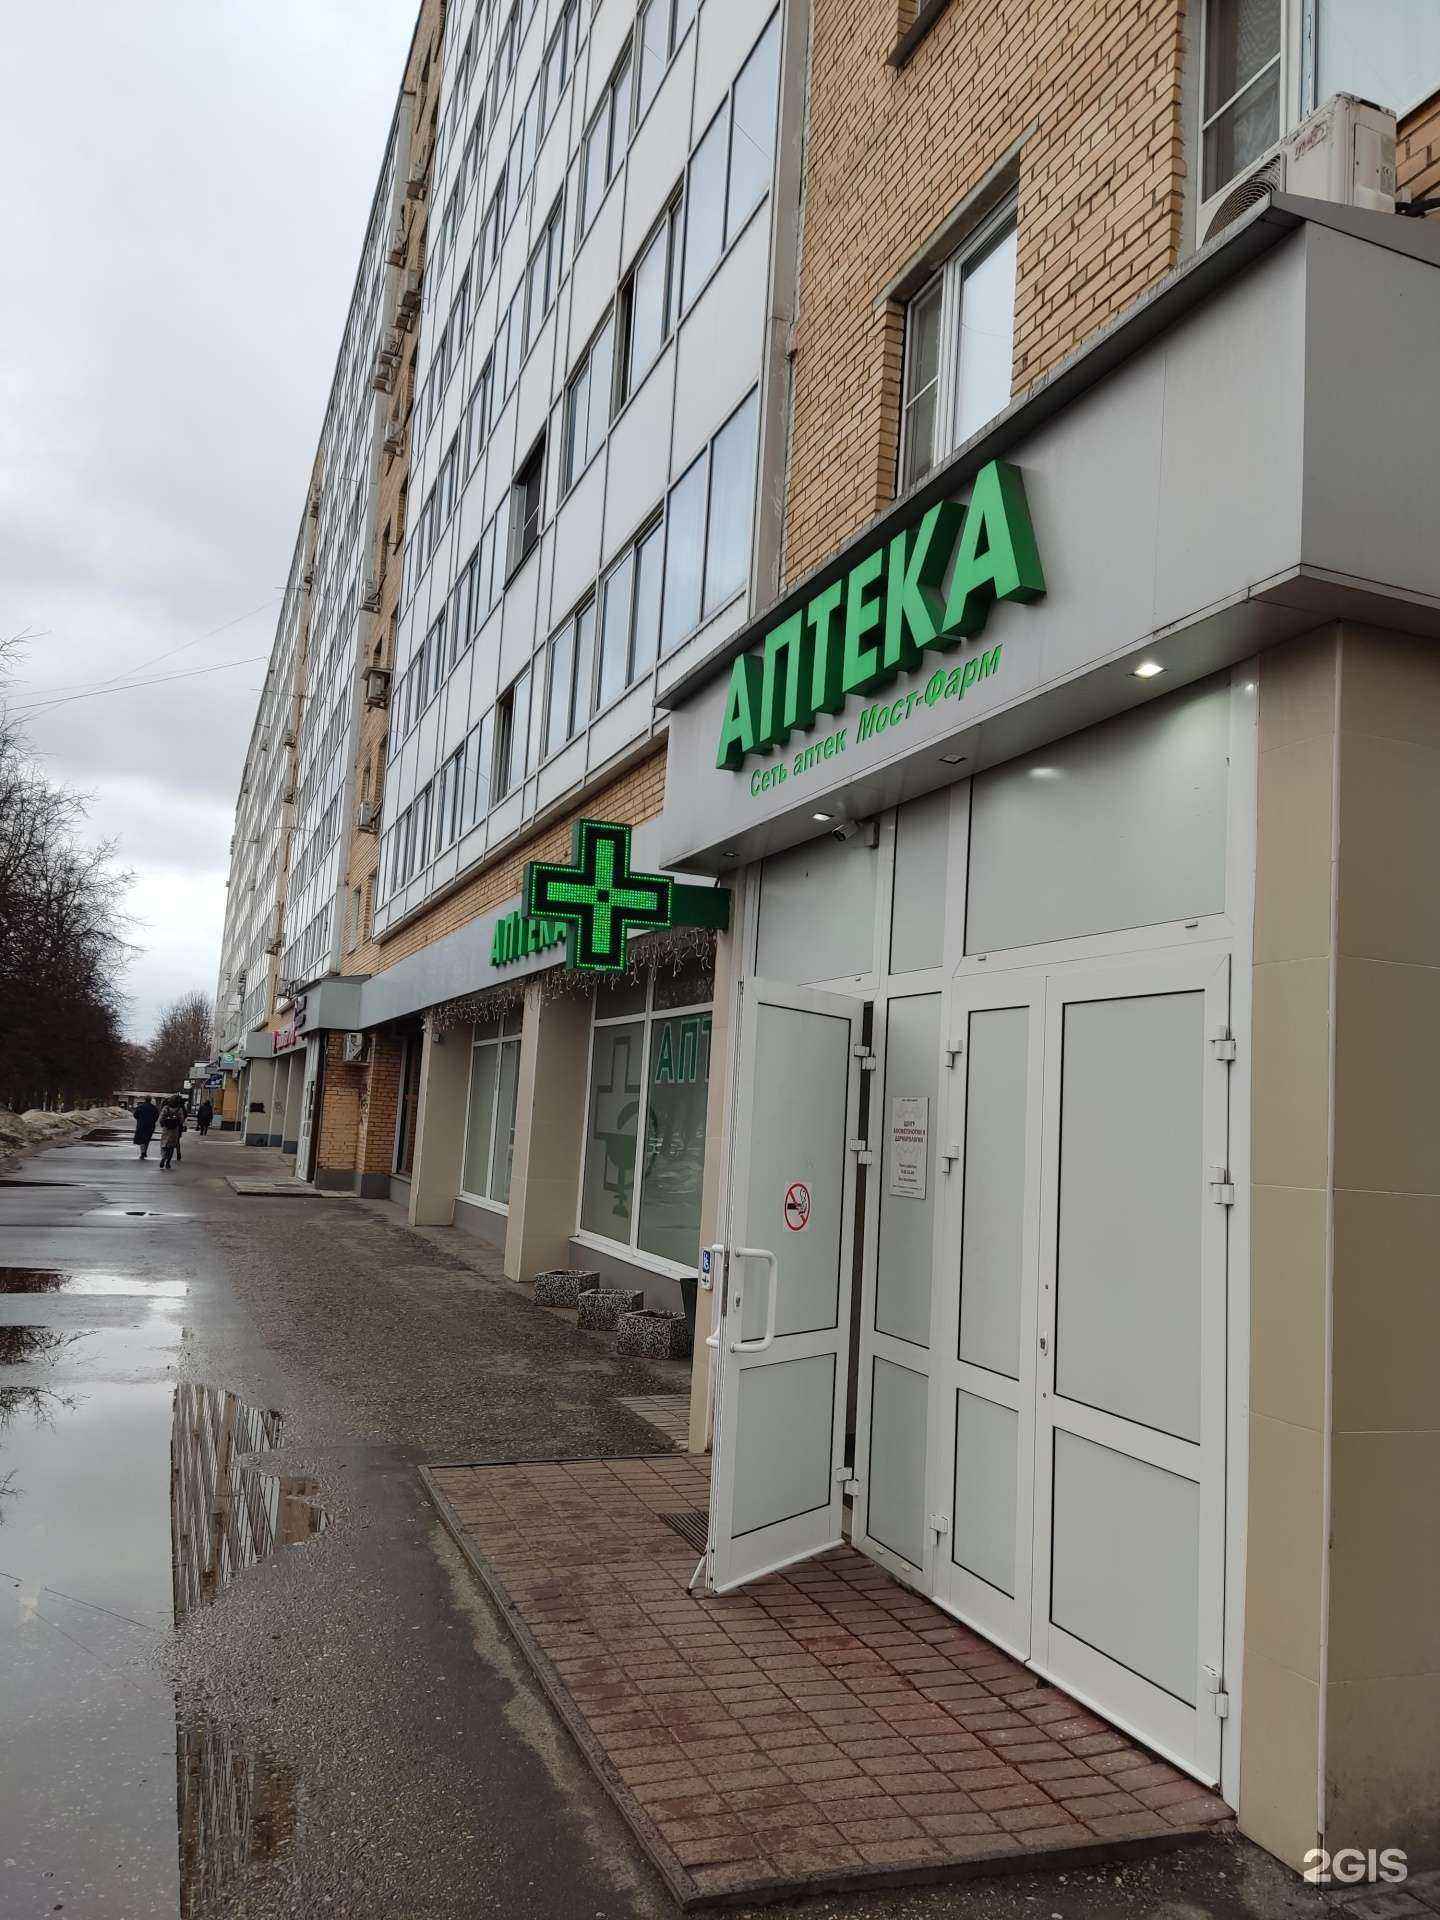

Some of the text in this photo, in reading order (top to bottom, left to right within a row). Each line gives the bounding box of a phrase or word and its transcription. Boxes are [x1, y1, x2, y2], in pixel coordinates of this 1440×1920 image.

[716, 459, 1045, 770] АПТЕКА
[750, 643, 1003, 797] Сеть аптек Мост-Фарм
